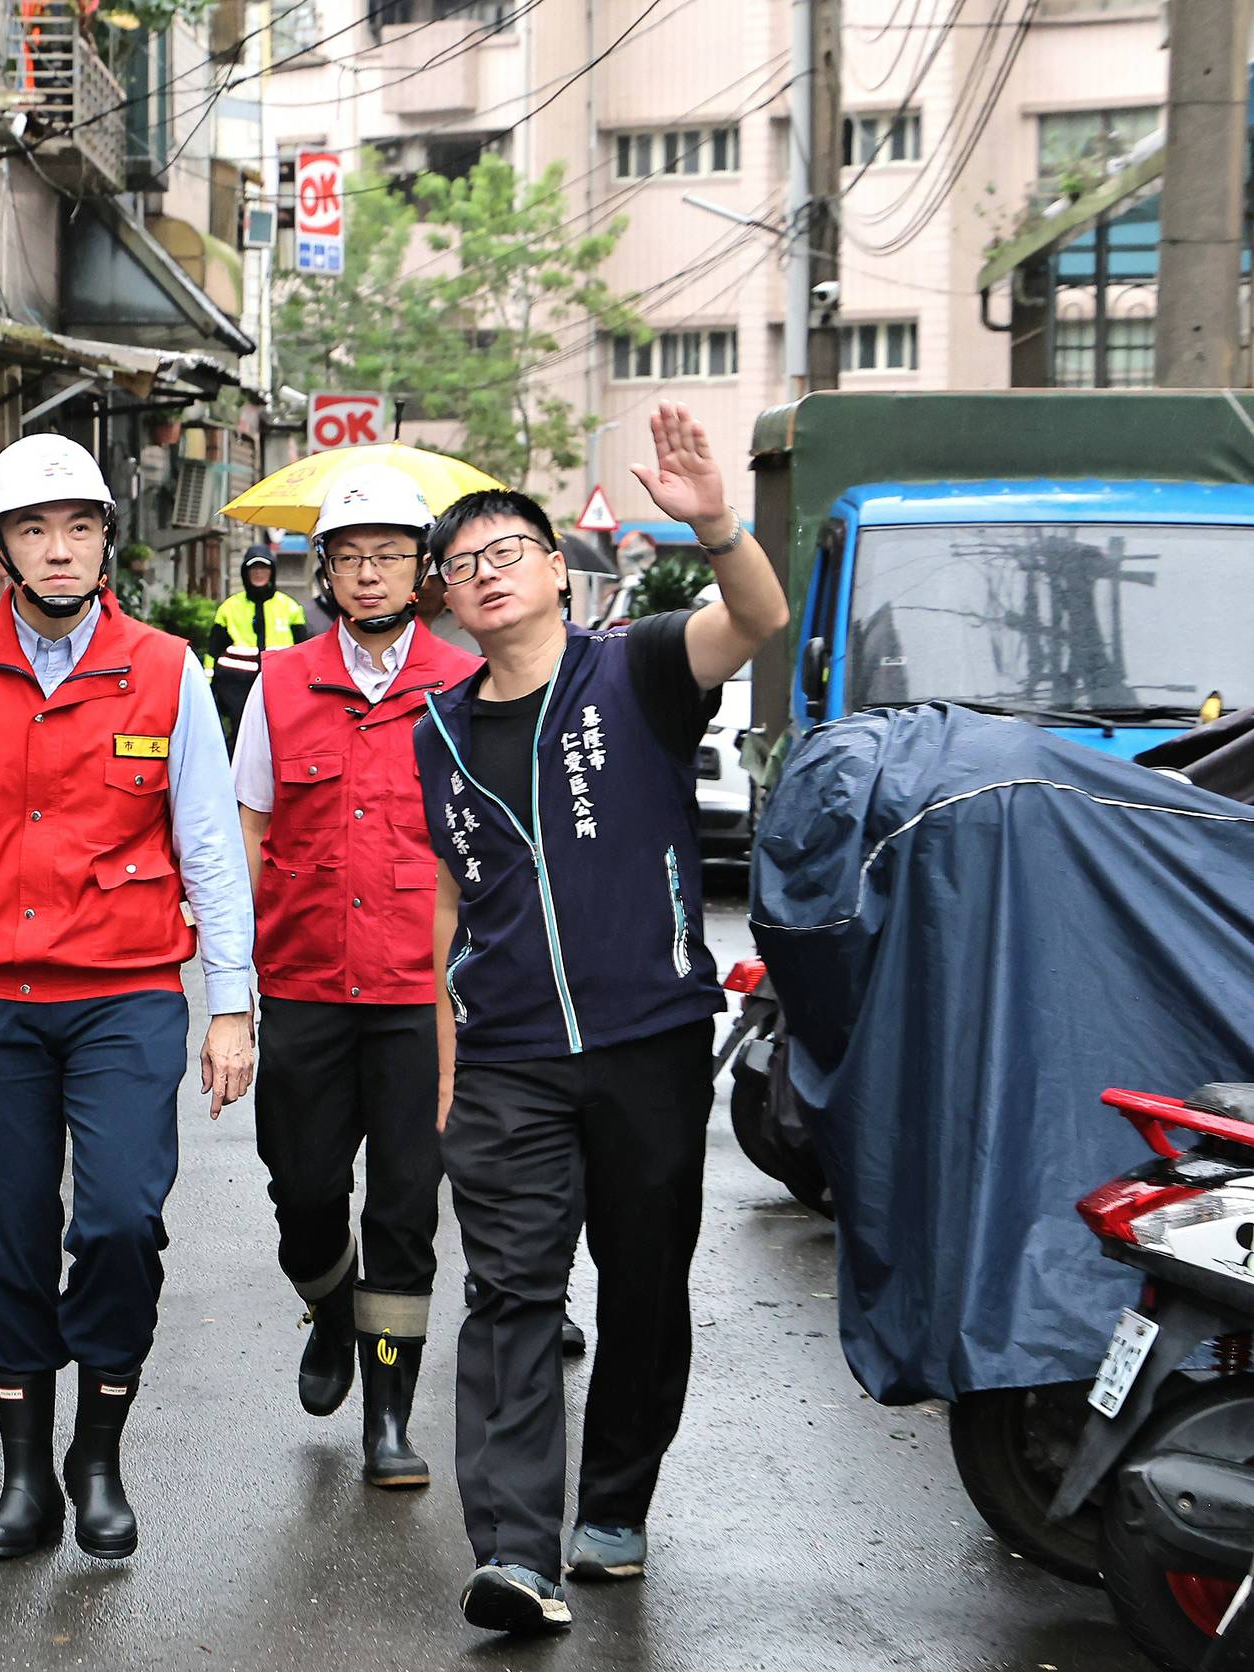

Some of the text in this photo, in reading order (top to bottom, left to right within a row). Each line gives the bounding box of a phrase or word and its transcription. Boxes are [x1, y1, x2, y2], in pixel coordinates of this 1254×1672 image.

[300, 172, 340, 217] OK
[314, 409, 378, 447] OK
[123, 740, 162, 753] 市長
[581, 705, 606, 771] 基隆市
